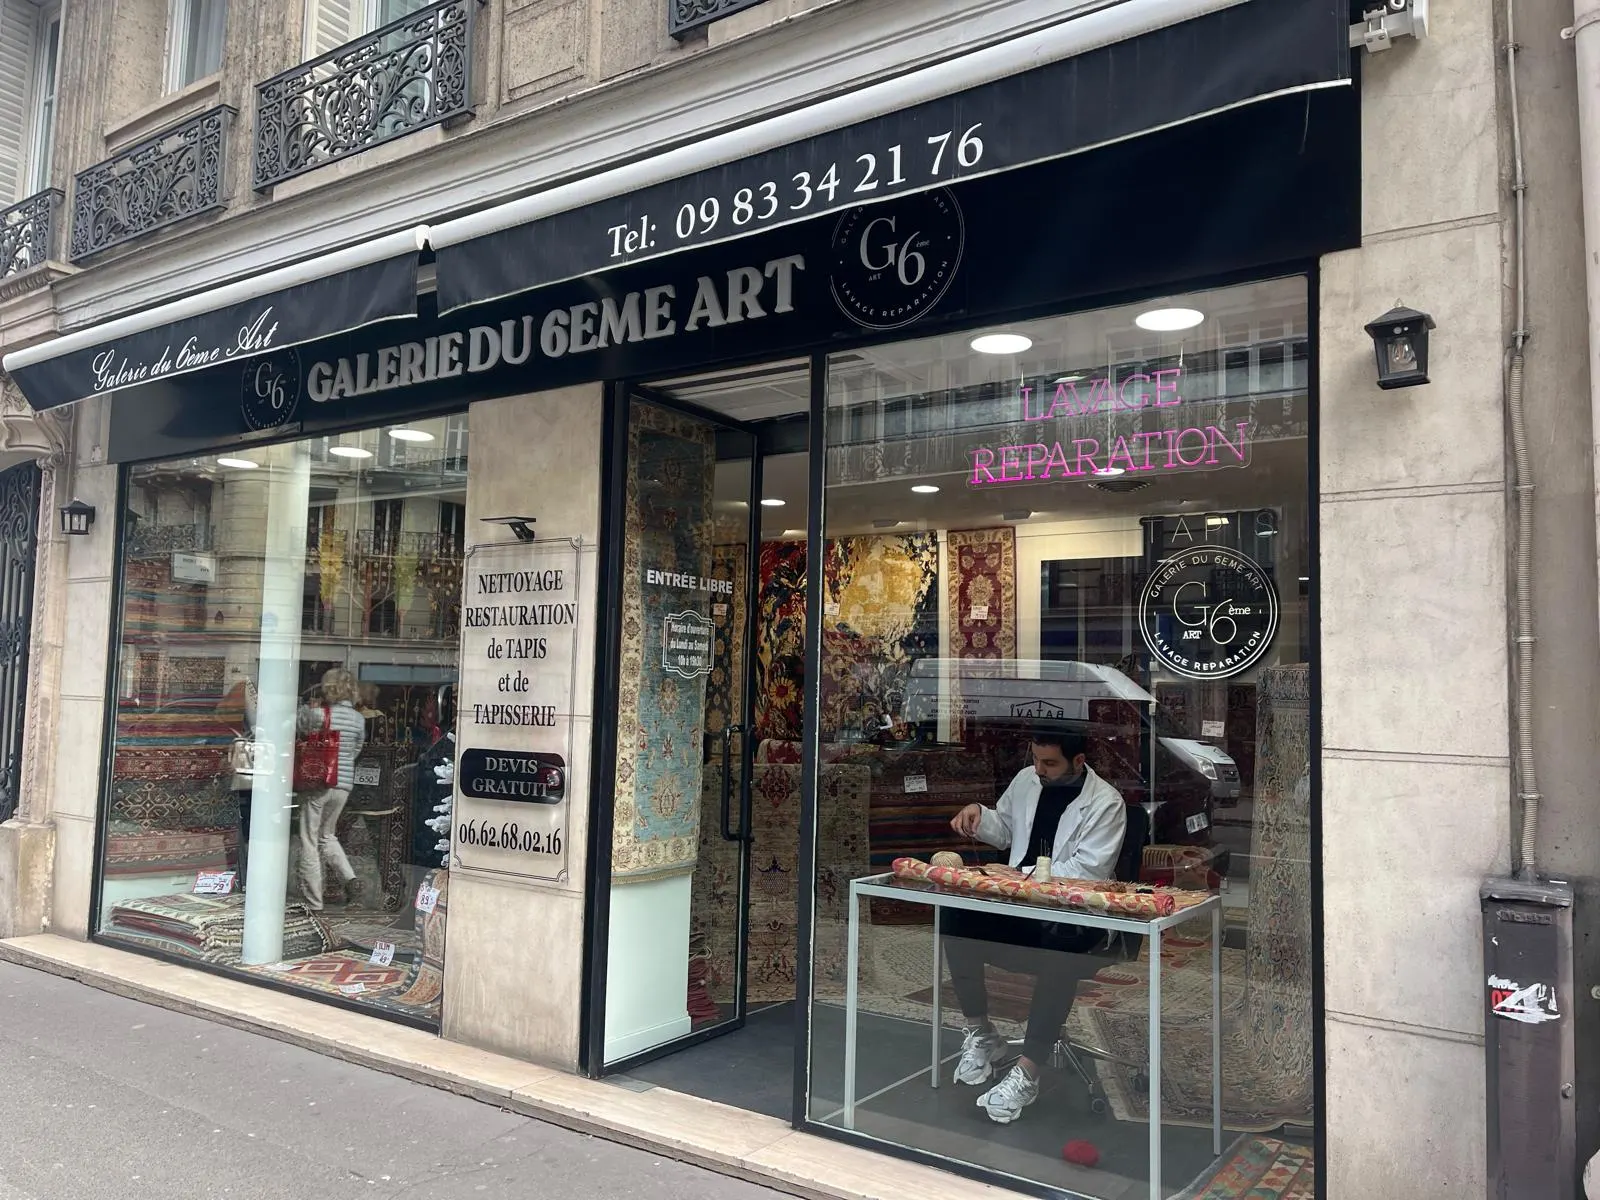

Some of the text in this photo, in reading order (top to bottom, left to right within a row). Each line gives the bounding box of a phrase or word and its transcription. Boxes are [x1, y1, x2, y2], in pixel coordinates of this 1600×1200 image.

[608, 122, 984, 257] Tel: 09 83 34 21 76
[882, 260, 948, 317] REPARATION
[307, 254, 805, 403] GALERIE DU 6EME ART
[92, 349, 147, 391] Galerie
[151, 346, 171, 376] du
[175, 336, 220, 369] 6ème
[225, 306, 279, 357] Art
[1020, 368, 1182, 422] LAVAGE
[971, 422, 1249, 484] REPARATION
[1143, 512, 1278, 544] TAPIS
[477, 569, 563, 595] NETTOYAGE
[646, 569, 733, 595] ENTRÉE LIBRE
[1151, 555, 1263, 598] GALERIE DU 6EME ART
[465, 603, 575, 628] RESTAURATION
[1228, 603, 1251, 615] ème
[487, 638, 547, 660] de TAPIS
[1182, 630, 1202, 640] ART
[1154, 631, 1261, 671] LAVAGE REPARATION
[498, 671, 529, 693] et de
[473, 703, 556, 728] TAPISSERIE
[485, 756, 538, 775] DEVIS
[472, 777, 551, 798] GRATUIT
[459, 819, 562, 855] 06.62.68.02.16
